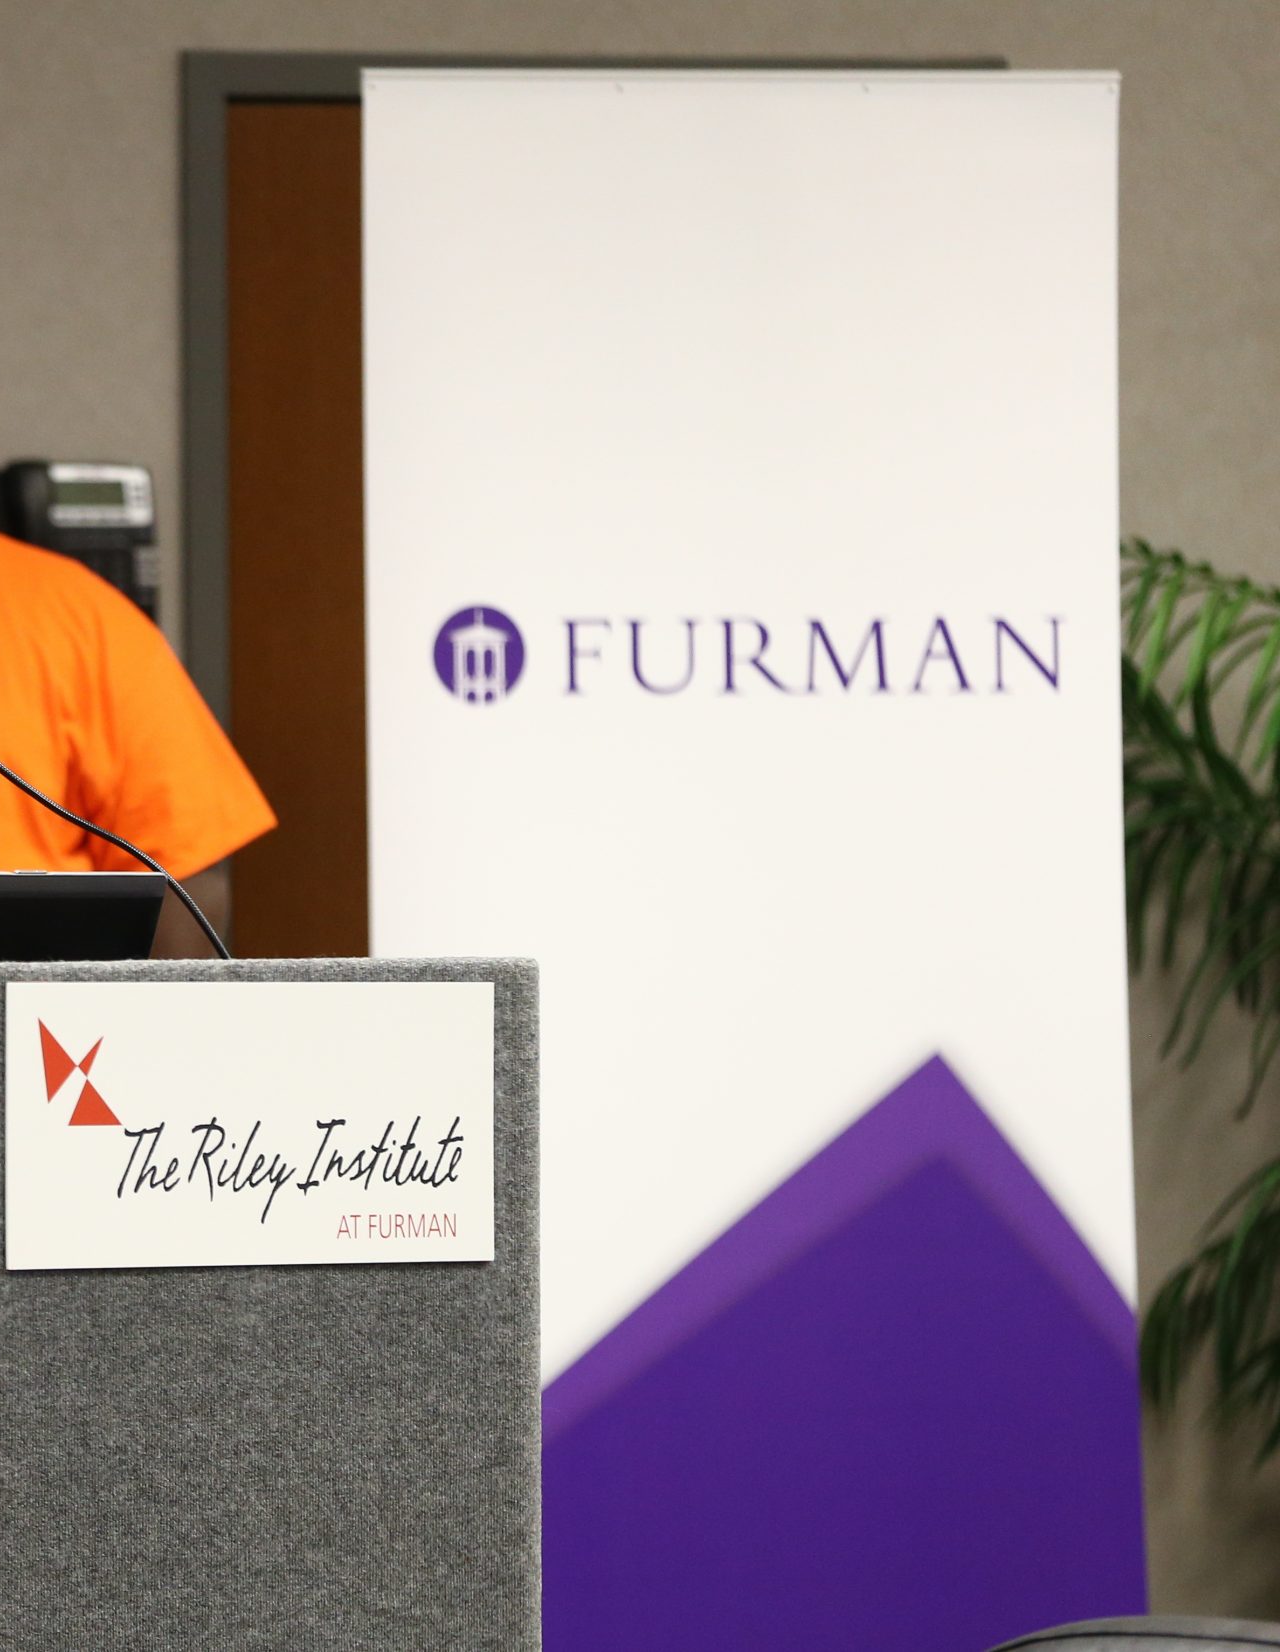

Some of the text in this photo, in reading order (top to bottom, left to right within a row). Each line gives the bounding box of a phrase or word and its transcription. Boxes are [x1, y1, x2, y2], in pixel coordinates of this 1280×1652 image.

[562, 614, 1066, 697] FURMAN
[117, 1115, 465, 1225] The Riley Institute
[336, 1212, 458, 1240] AT FURMAN
